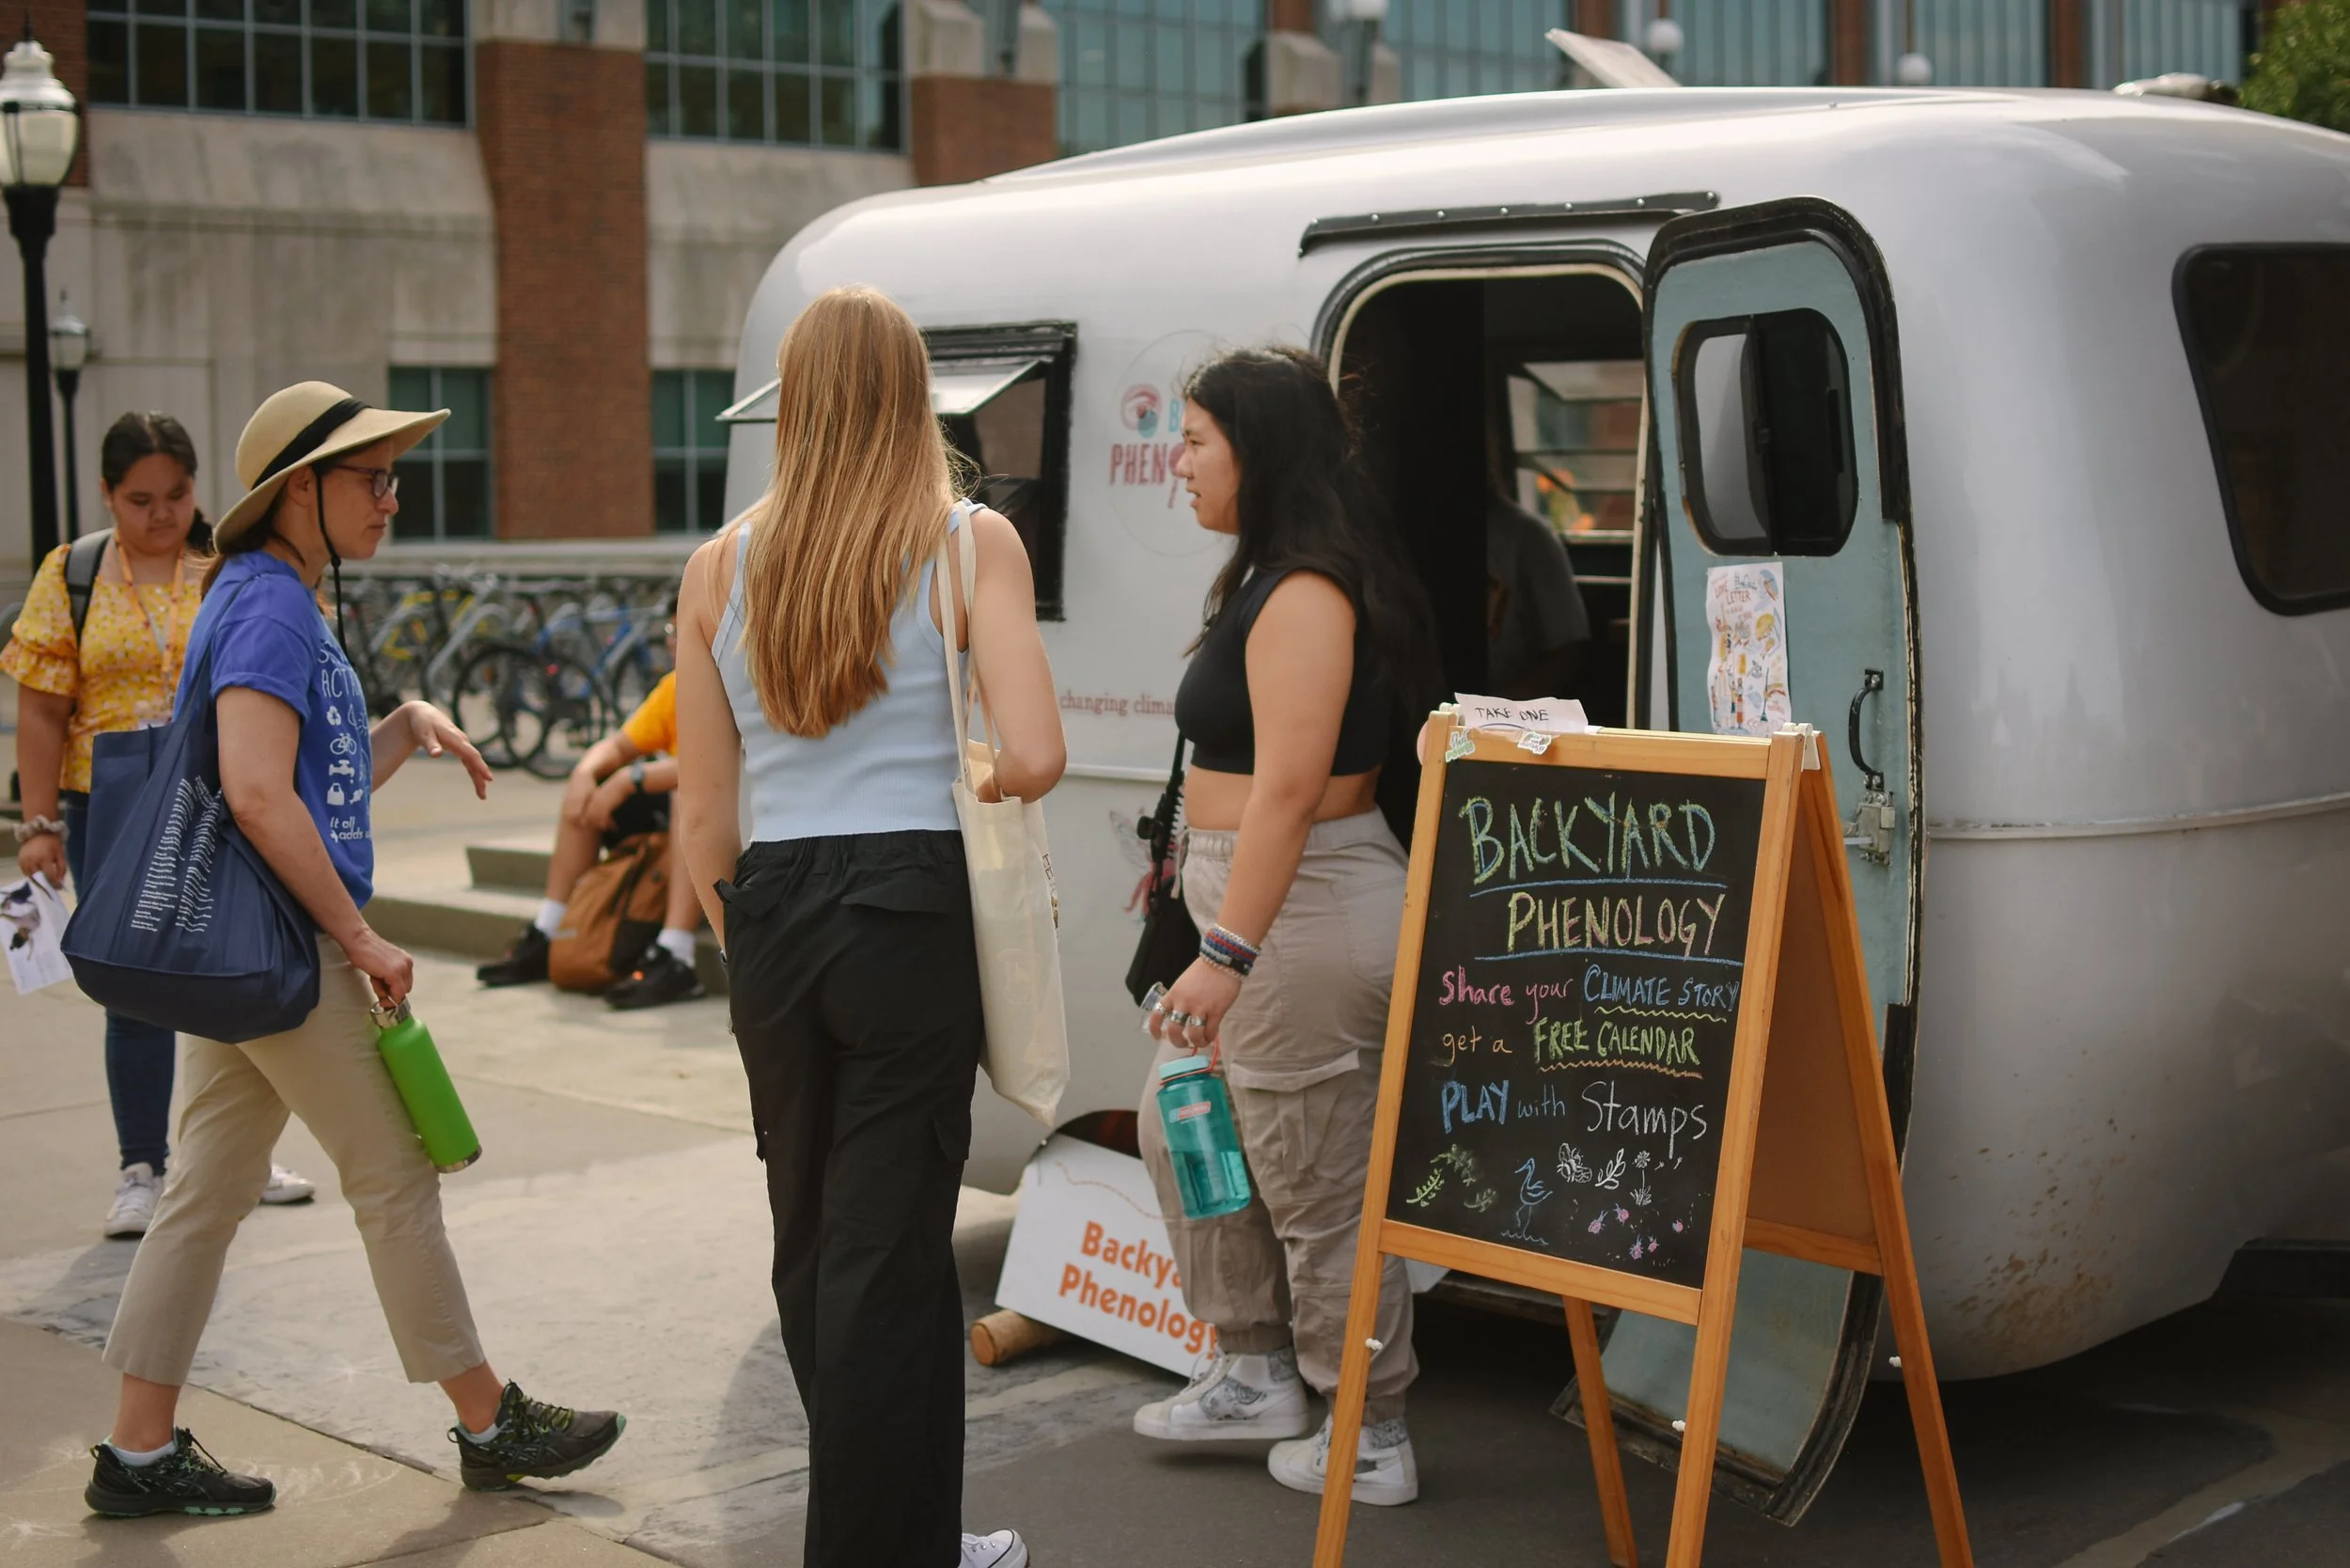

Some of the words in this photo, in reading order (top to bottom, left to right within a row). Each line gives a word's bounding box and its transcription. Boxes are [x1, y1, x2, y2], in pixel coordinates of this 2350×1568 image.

[1060, 690, 1128, 716] changing
[1134, 694, 1175, 715] clima
[1475, 707, 1512, 720] TAKE
[1519, 709, 1549, 722] ONE
[330, 816, 339, 829] It
[341, 816, 355, 829] all
[338, 826, 363, 839] adds
[1459, 792, 1716, 886] BACKYARD
[1507, 890, 1726, 961] PHENOLOGY
[1438, 965, 1514, 1006] Share
[1526, 979, 1574, 1025] your
[1583, 964, 1671, 1005] CLIMATE
[1677, 978, 1740, 1012] STORY
[1442, 1025, 1481, 1067] get
[1492, 1038, 1512, 1055] a
[1533, 1016, 1590, 1064] FREE
[1597, 1020, 1700, 1066] CALENDAR
[1441, 1079, 1510, 1134] PLAY
[1518, 1084, 1566, 1120] with
[1581, 1080, 1708, 1159] Stamps
